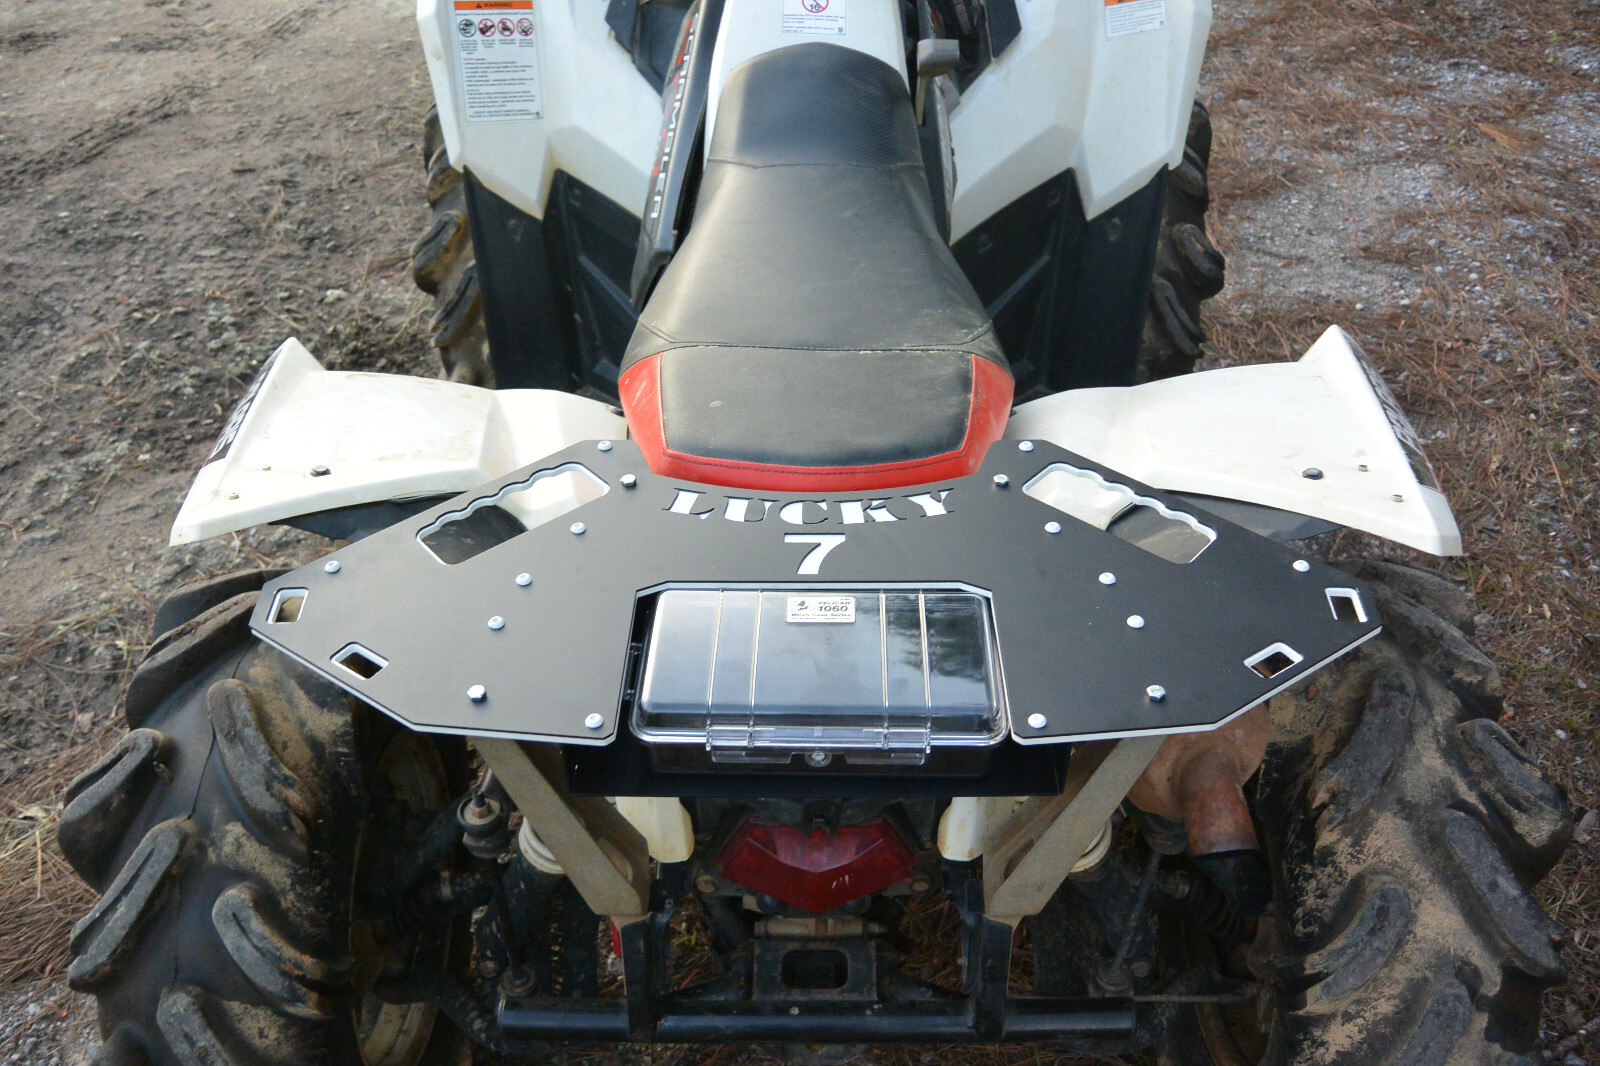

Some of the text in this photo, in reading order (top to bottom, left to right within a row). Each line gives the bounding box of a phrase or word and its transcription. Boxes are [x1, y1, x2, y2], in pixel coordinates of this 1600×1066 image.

[809, 3, 820, 11] 16
[662, 488, 955, 525] LUCKY
[784, 533, 846, 575] 7
